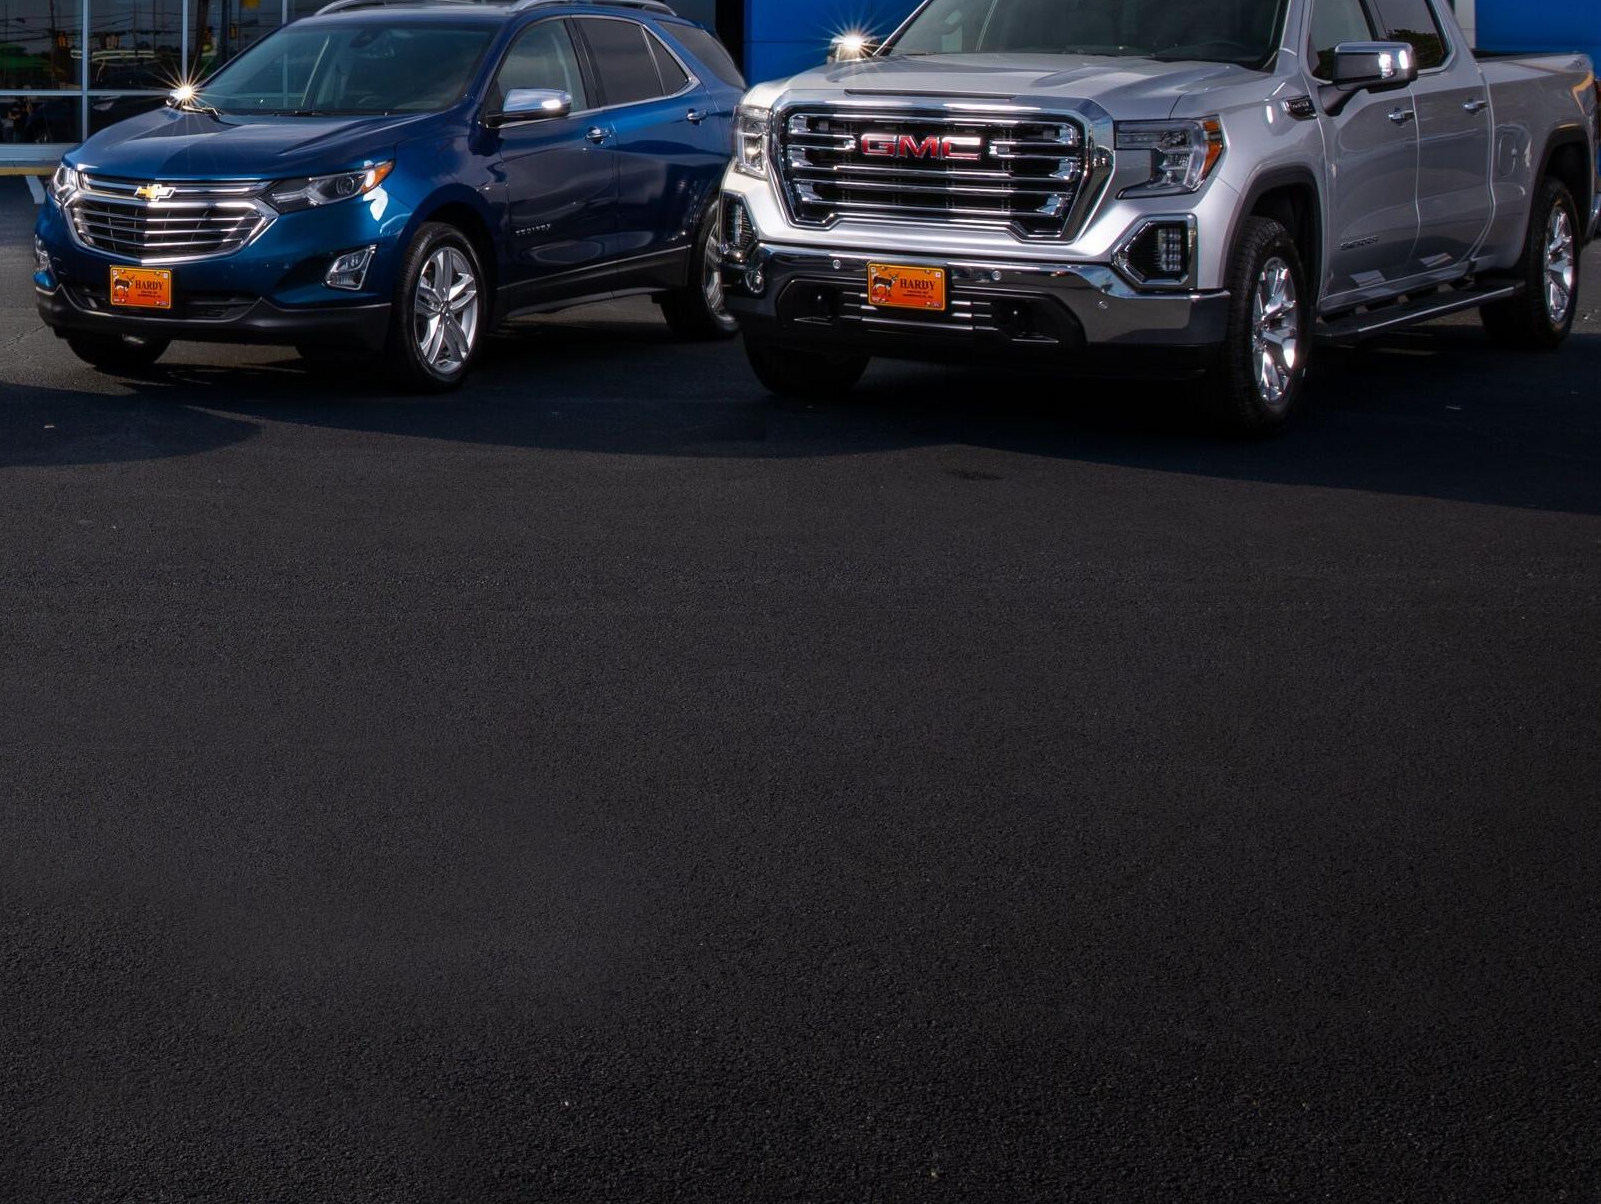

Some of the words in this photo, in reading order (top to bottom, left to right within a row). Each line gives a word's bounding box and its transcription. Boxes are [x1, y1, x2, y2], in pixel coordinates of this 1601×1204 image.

[860, 133, 982, 161] GMC
[135, 280, 164, 291] HARDY
[900, 277, 936, 290] HARDY
